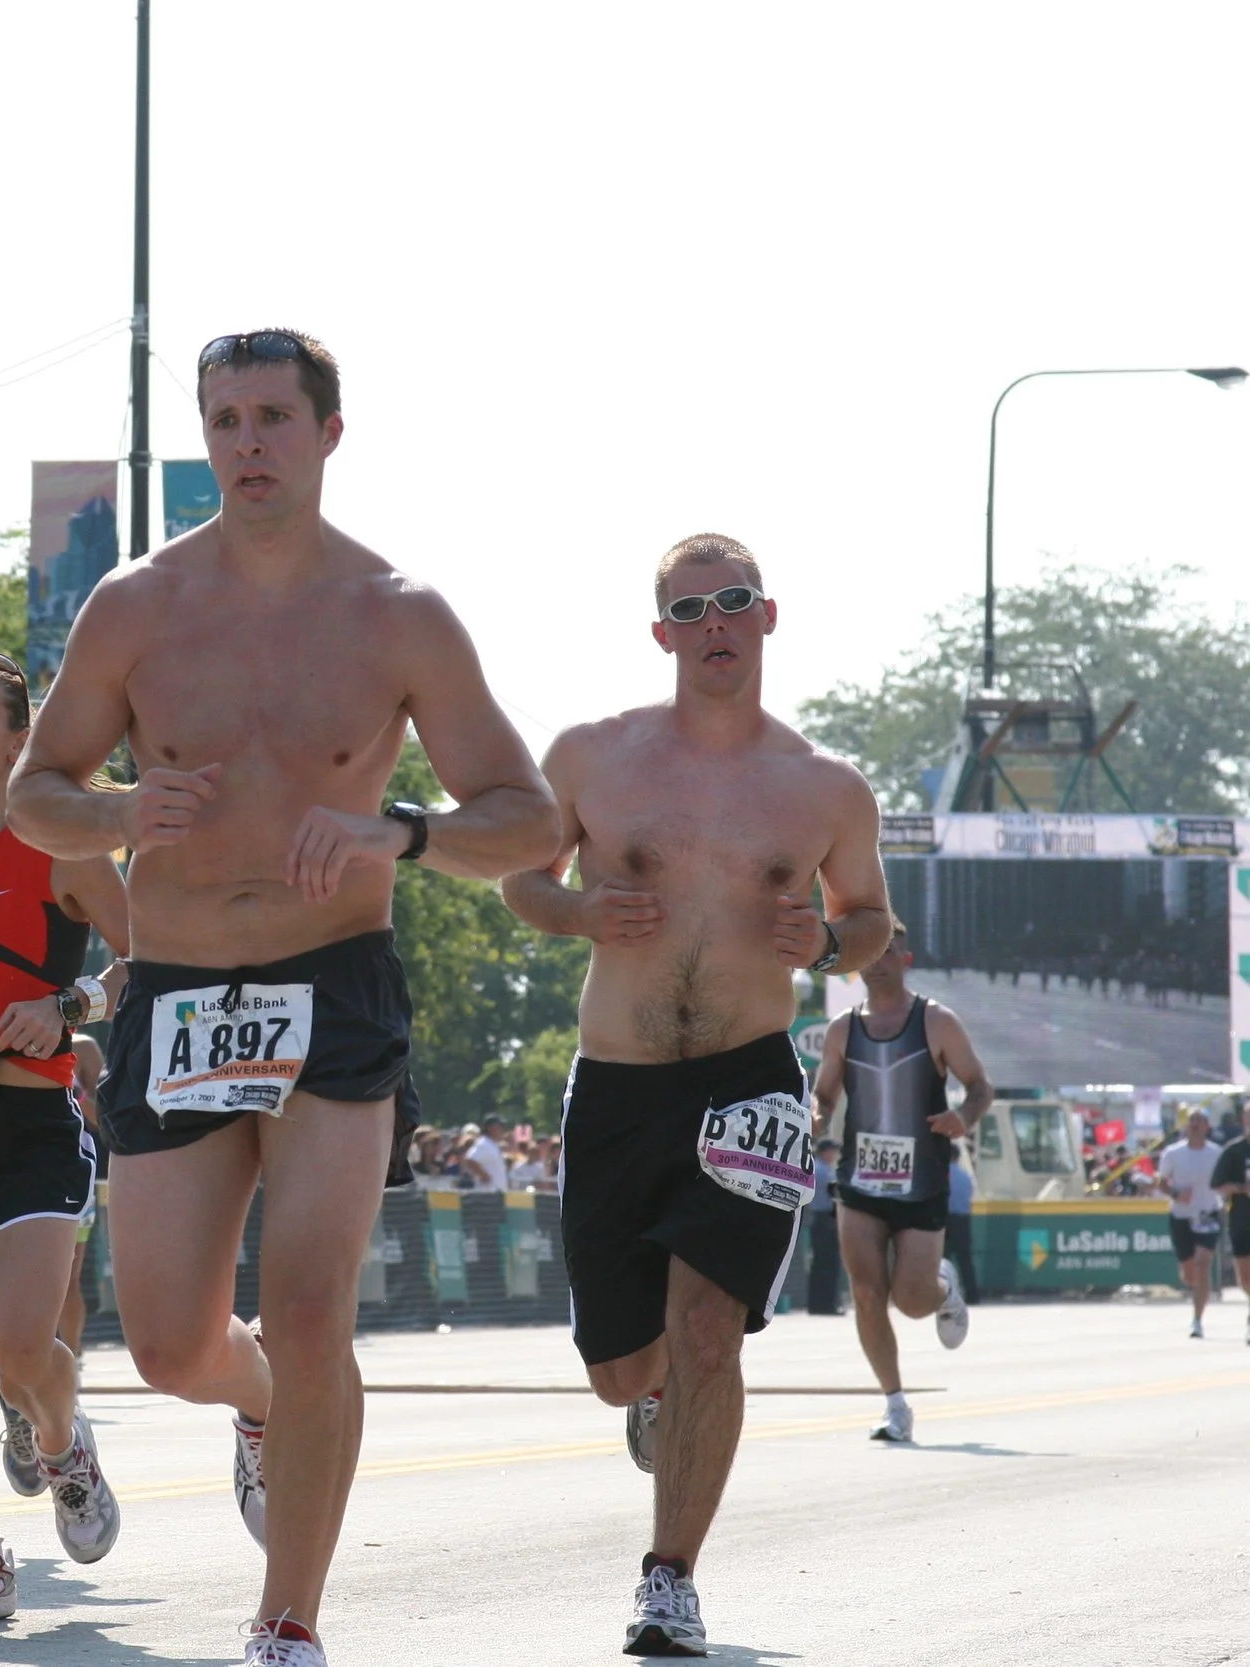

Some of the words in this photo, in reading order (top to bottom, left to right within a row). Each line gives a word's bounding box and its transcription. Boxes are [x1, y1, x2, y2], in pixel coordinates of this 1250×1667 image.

[253, 996, 288, 1010] Bank
[167, 1027, 192, 1076] A
[208, 1017, 291, 1070] 897
[785, 1101, 806, 1121] Bank
[718, 1154, 740, 1165] 30th
[741, 1158, 810, 1184] ANNIVERSARY
[870, 1149, 911, 1174] 3634
[1056, 1229, 1129, 1253] LaSalle
[1133, 1229, 1173, 1253] Ban
